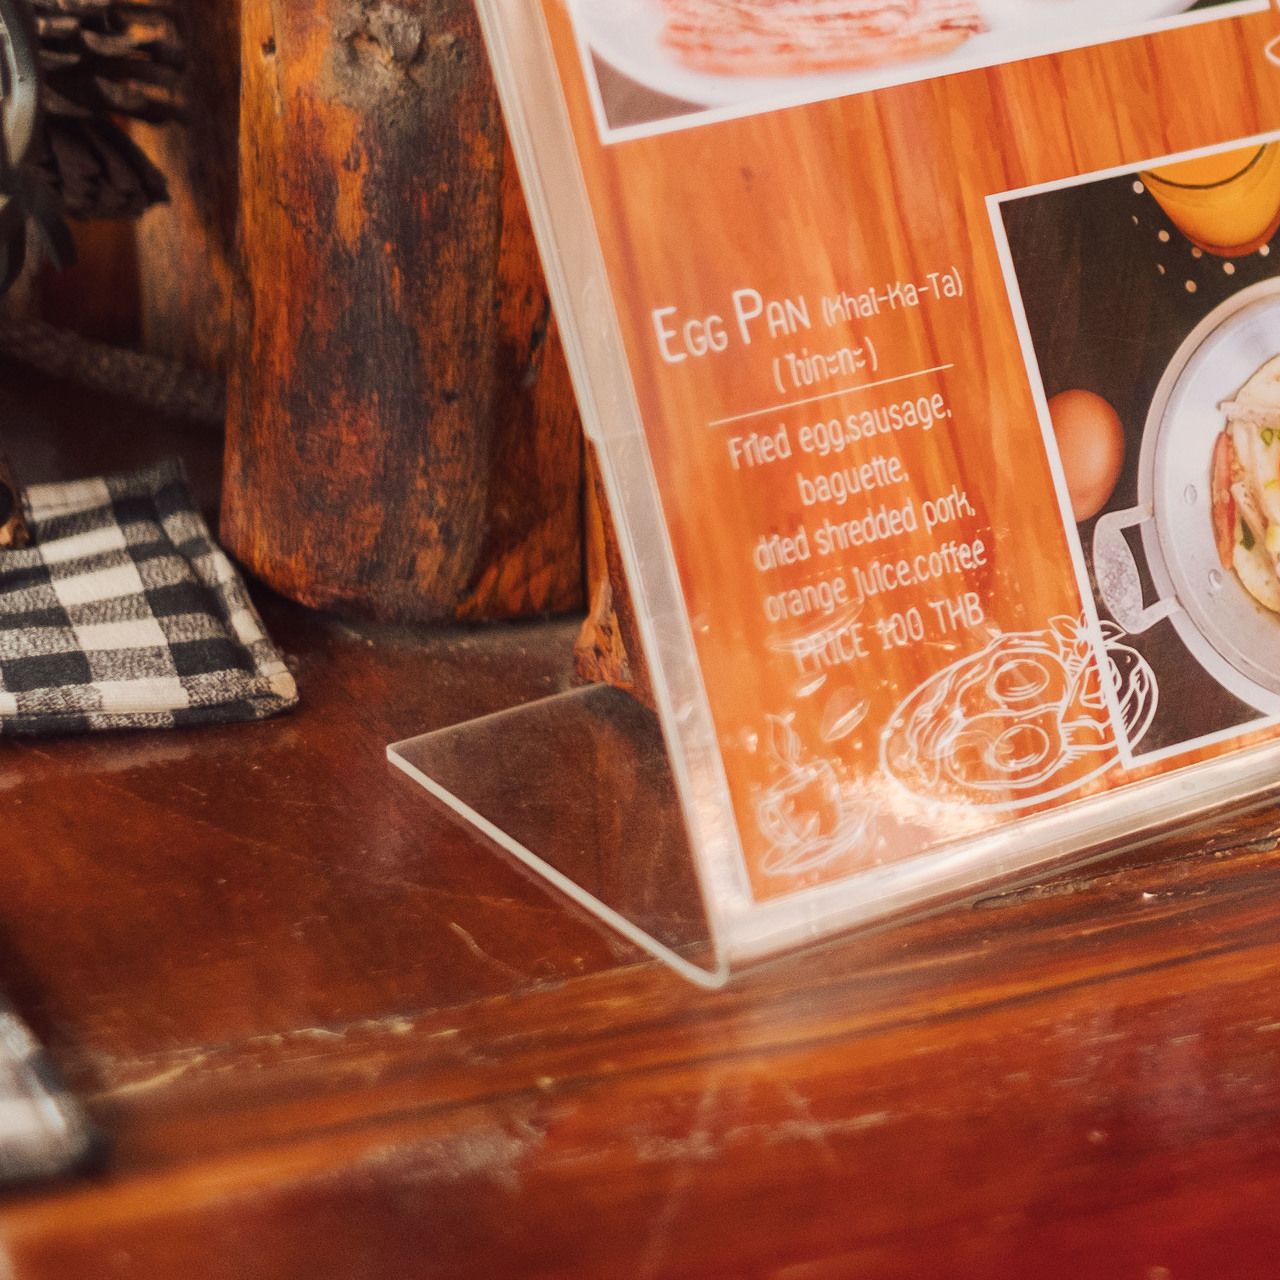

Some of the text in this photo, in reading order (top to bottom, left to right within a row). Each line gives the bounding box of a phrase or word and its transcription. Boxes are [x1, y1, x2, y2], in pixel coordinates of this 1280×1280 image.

[821, 266, 965, 328] (Khai-Ka-Ta)
[727, 422, 793, 470] Fried
[753, 524, 811, 572] dried
[814, 499, 919, 557] shredded
[763, 575, 848, 624] orange
[793, 591, 986, 676] PRICE 100 THB
